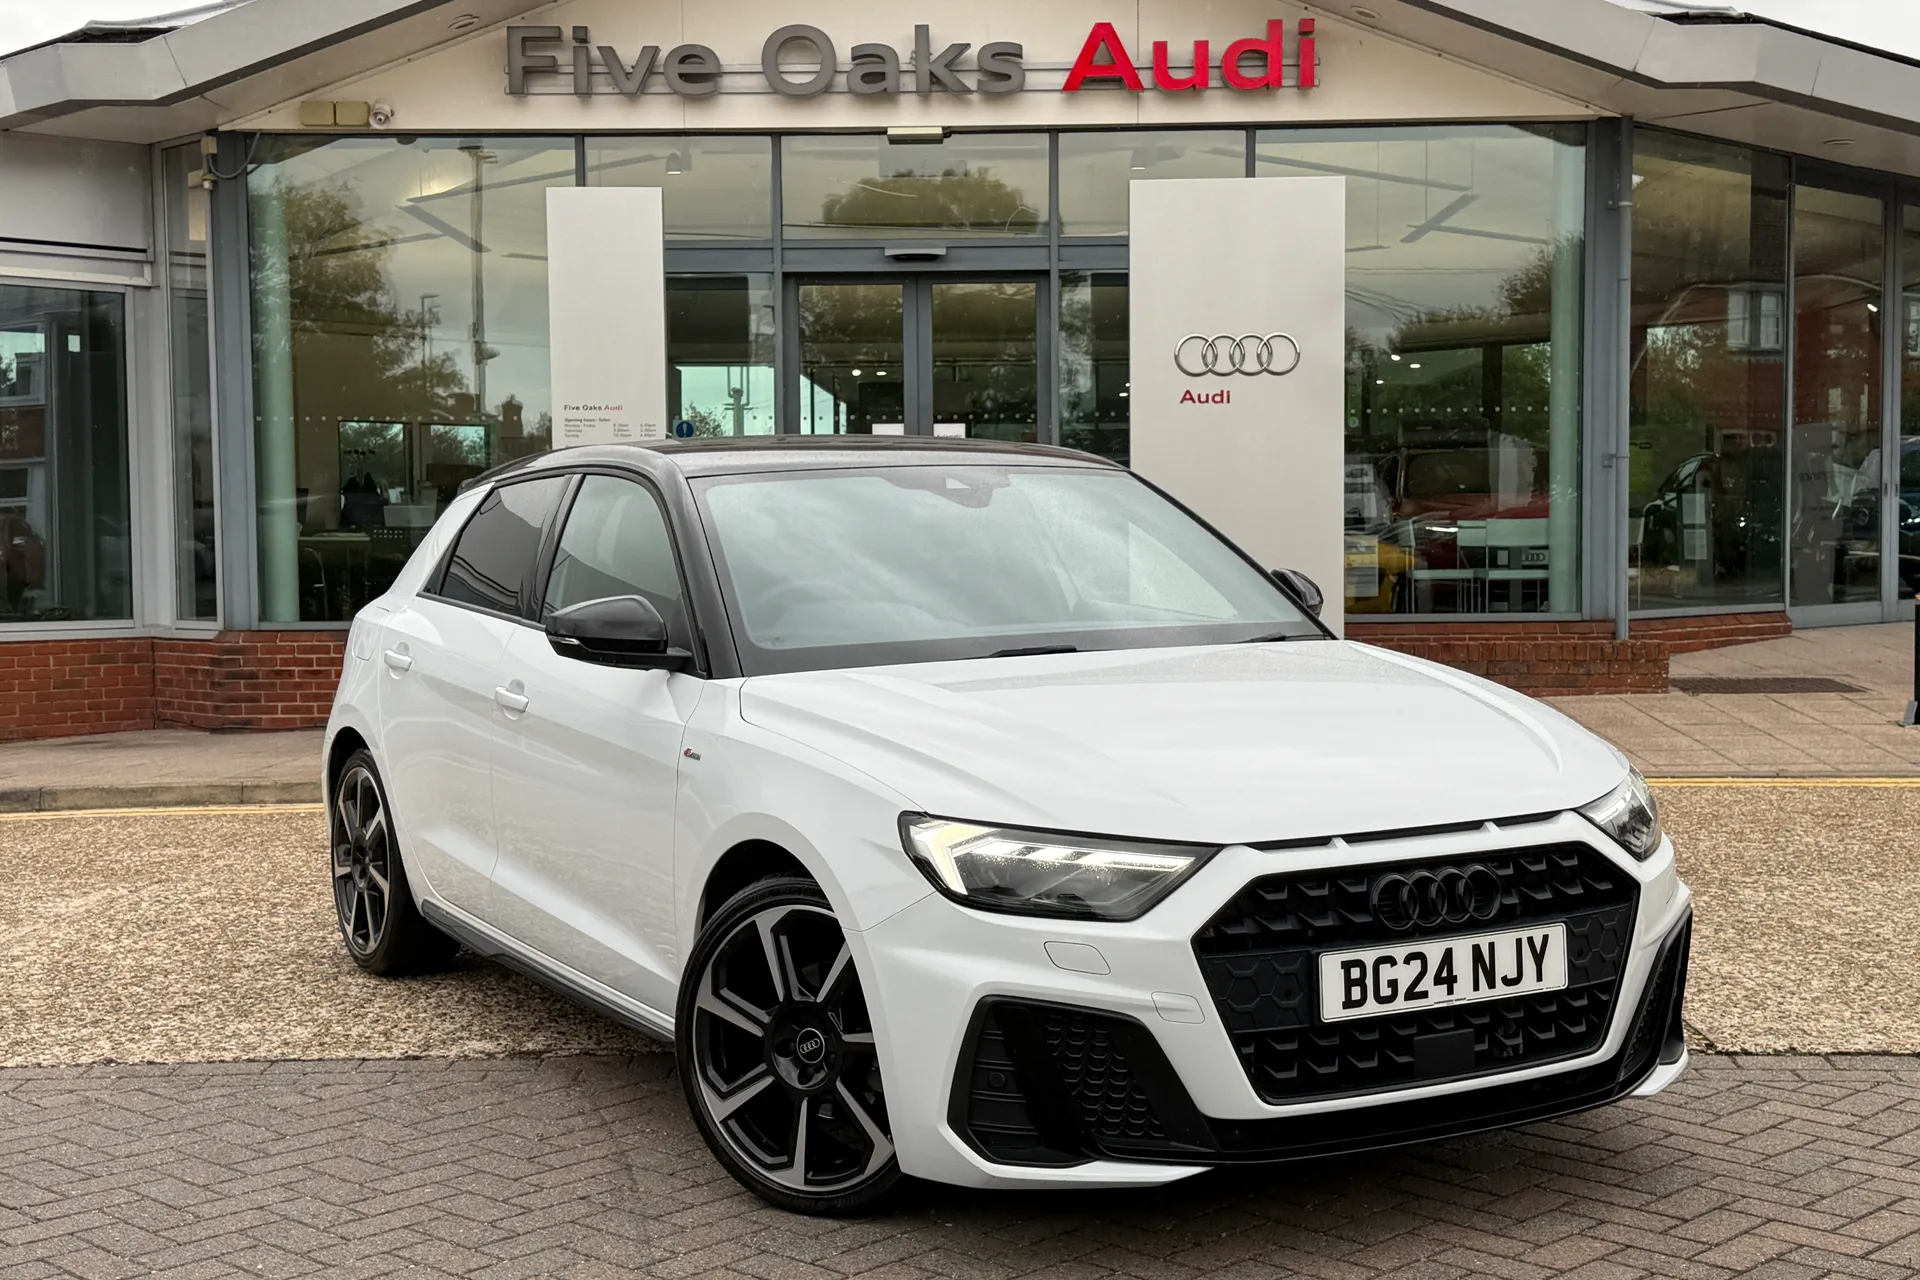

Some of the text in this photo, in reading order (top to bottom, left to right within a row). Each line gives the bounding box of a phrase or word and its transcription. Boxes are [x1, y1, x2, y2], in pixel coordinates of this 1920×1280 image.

[507, 18, 1316, 98] Five Oaks Audi
[1179, 389, 1231, 404] Audi
[1340, 934, 1549, 1010] BG24 NJY
